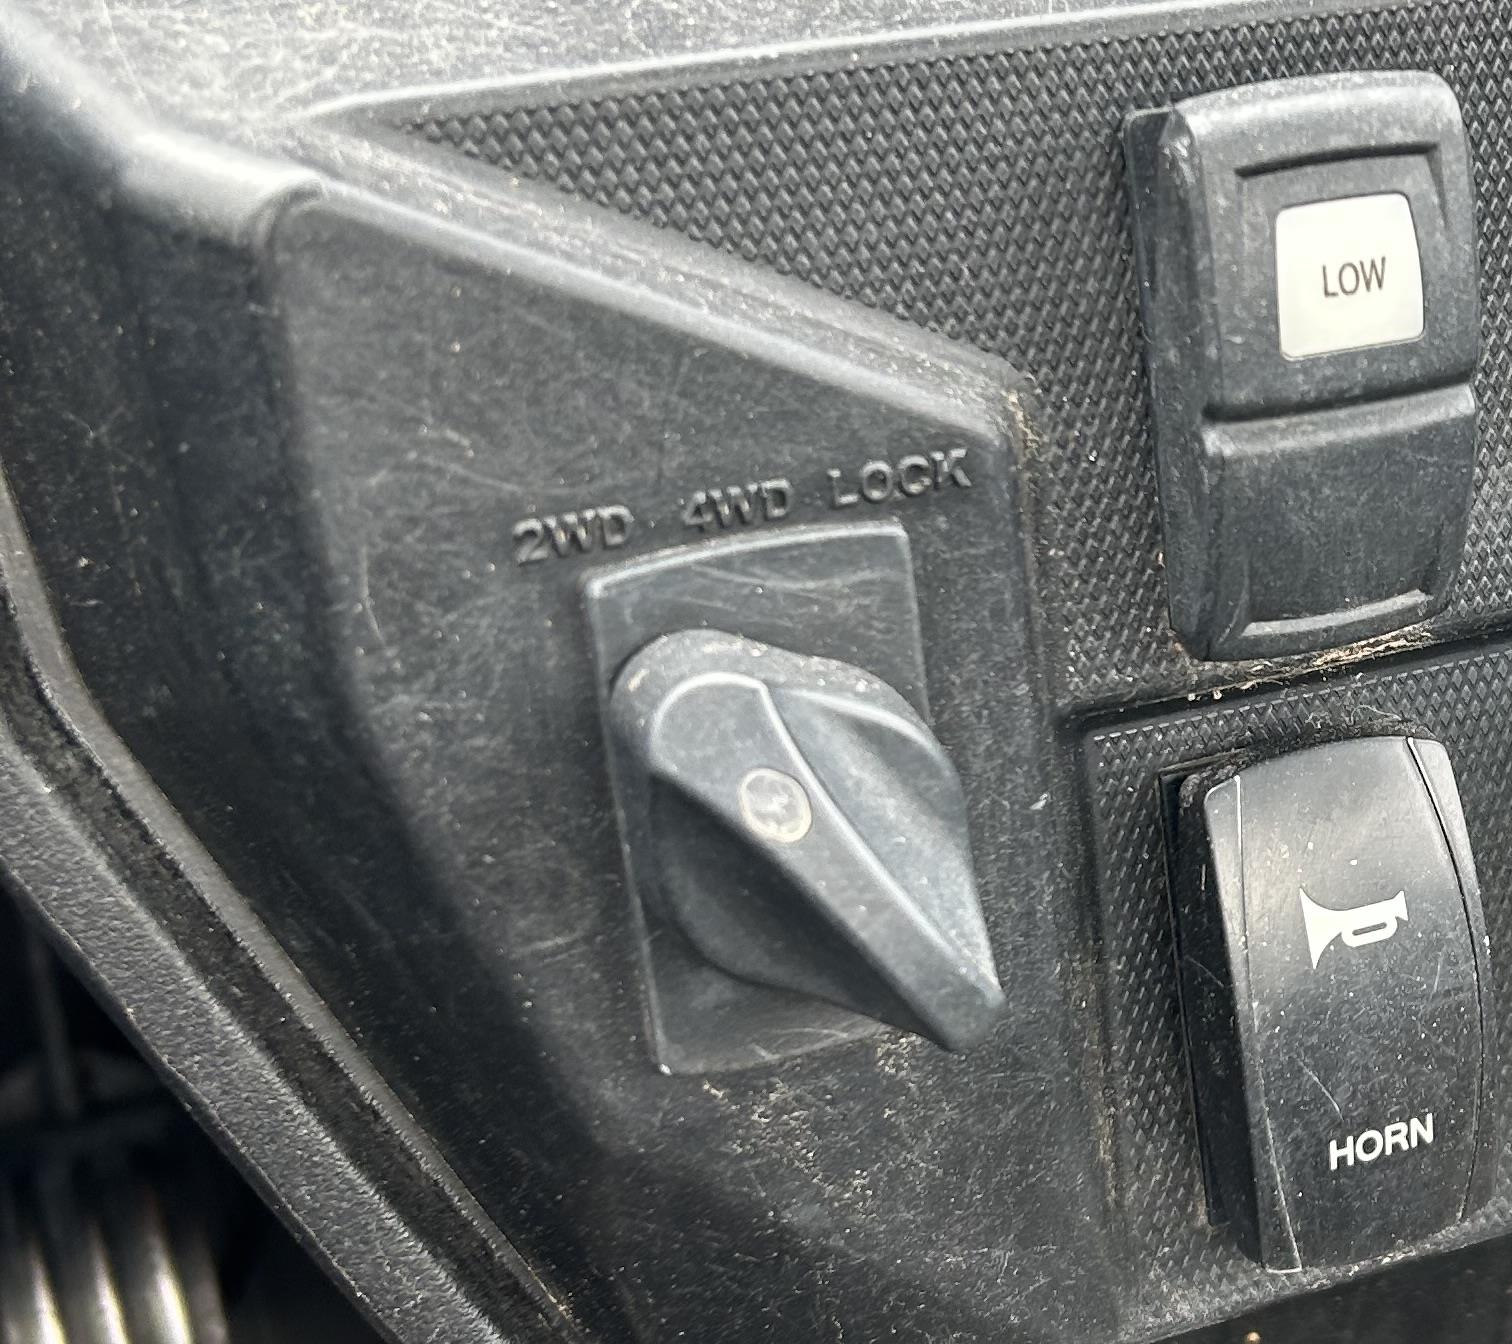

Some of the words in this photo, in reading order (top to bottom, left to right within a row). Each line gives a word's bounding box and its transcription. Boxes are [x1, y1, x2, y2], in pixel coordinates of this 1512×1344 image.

[1322, 256, 1386, 298] LOW
[512, 504, 634, 566] 2WD
[681, 477, 794, 530] 4WD
[827, 447, 972, 509] LOCK
[1329, 1113, 1434, 1171] HORN
